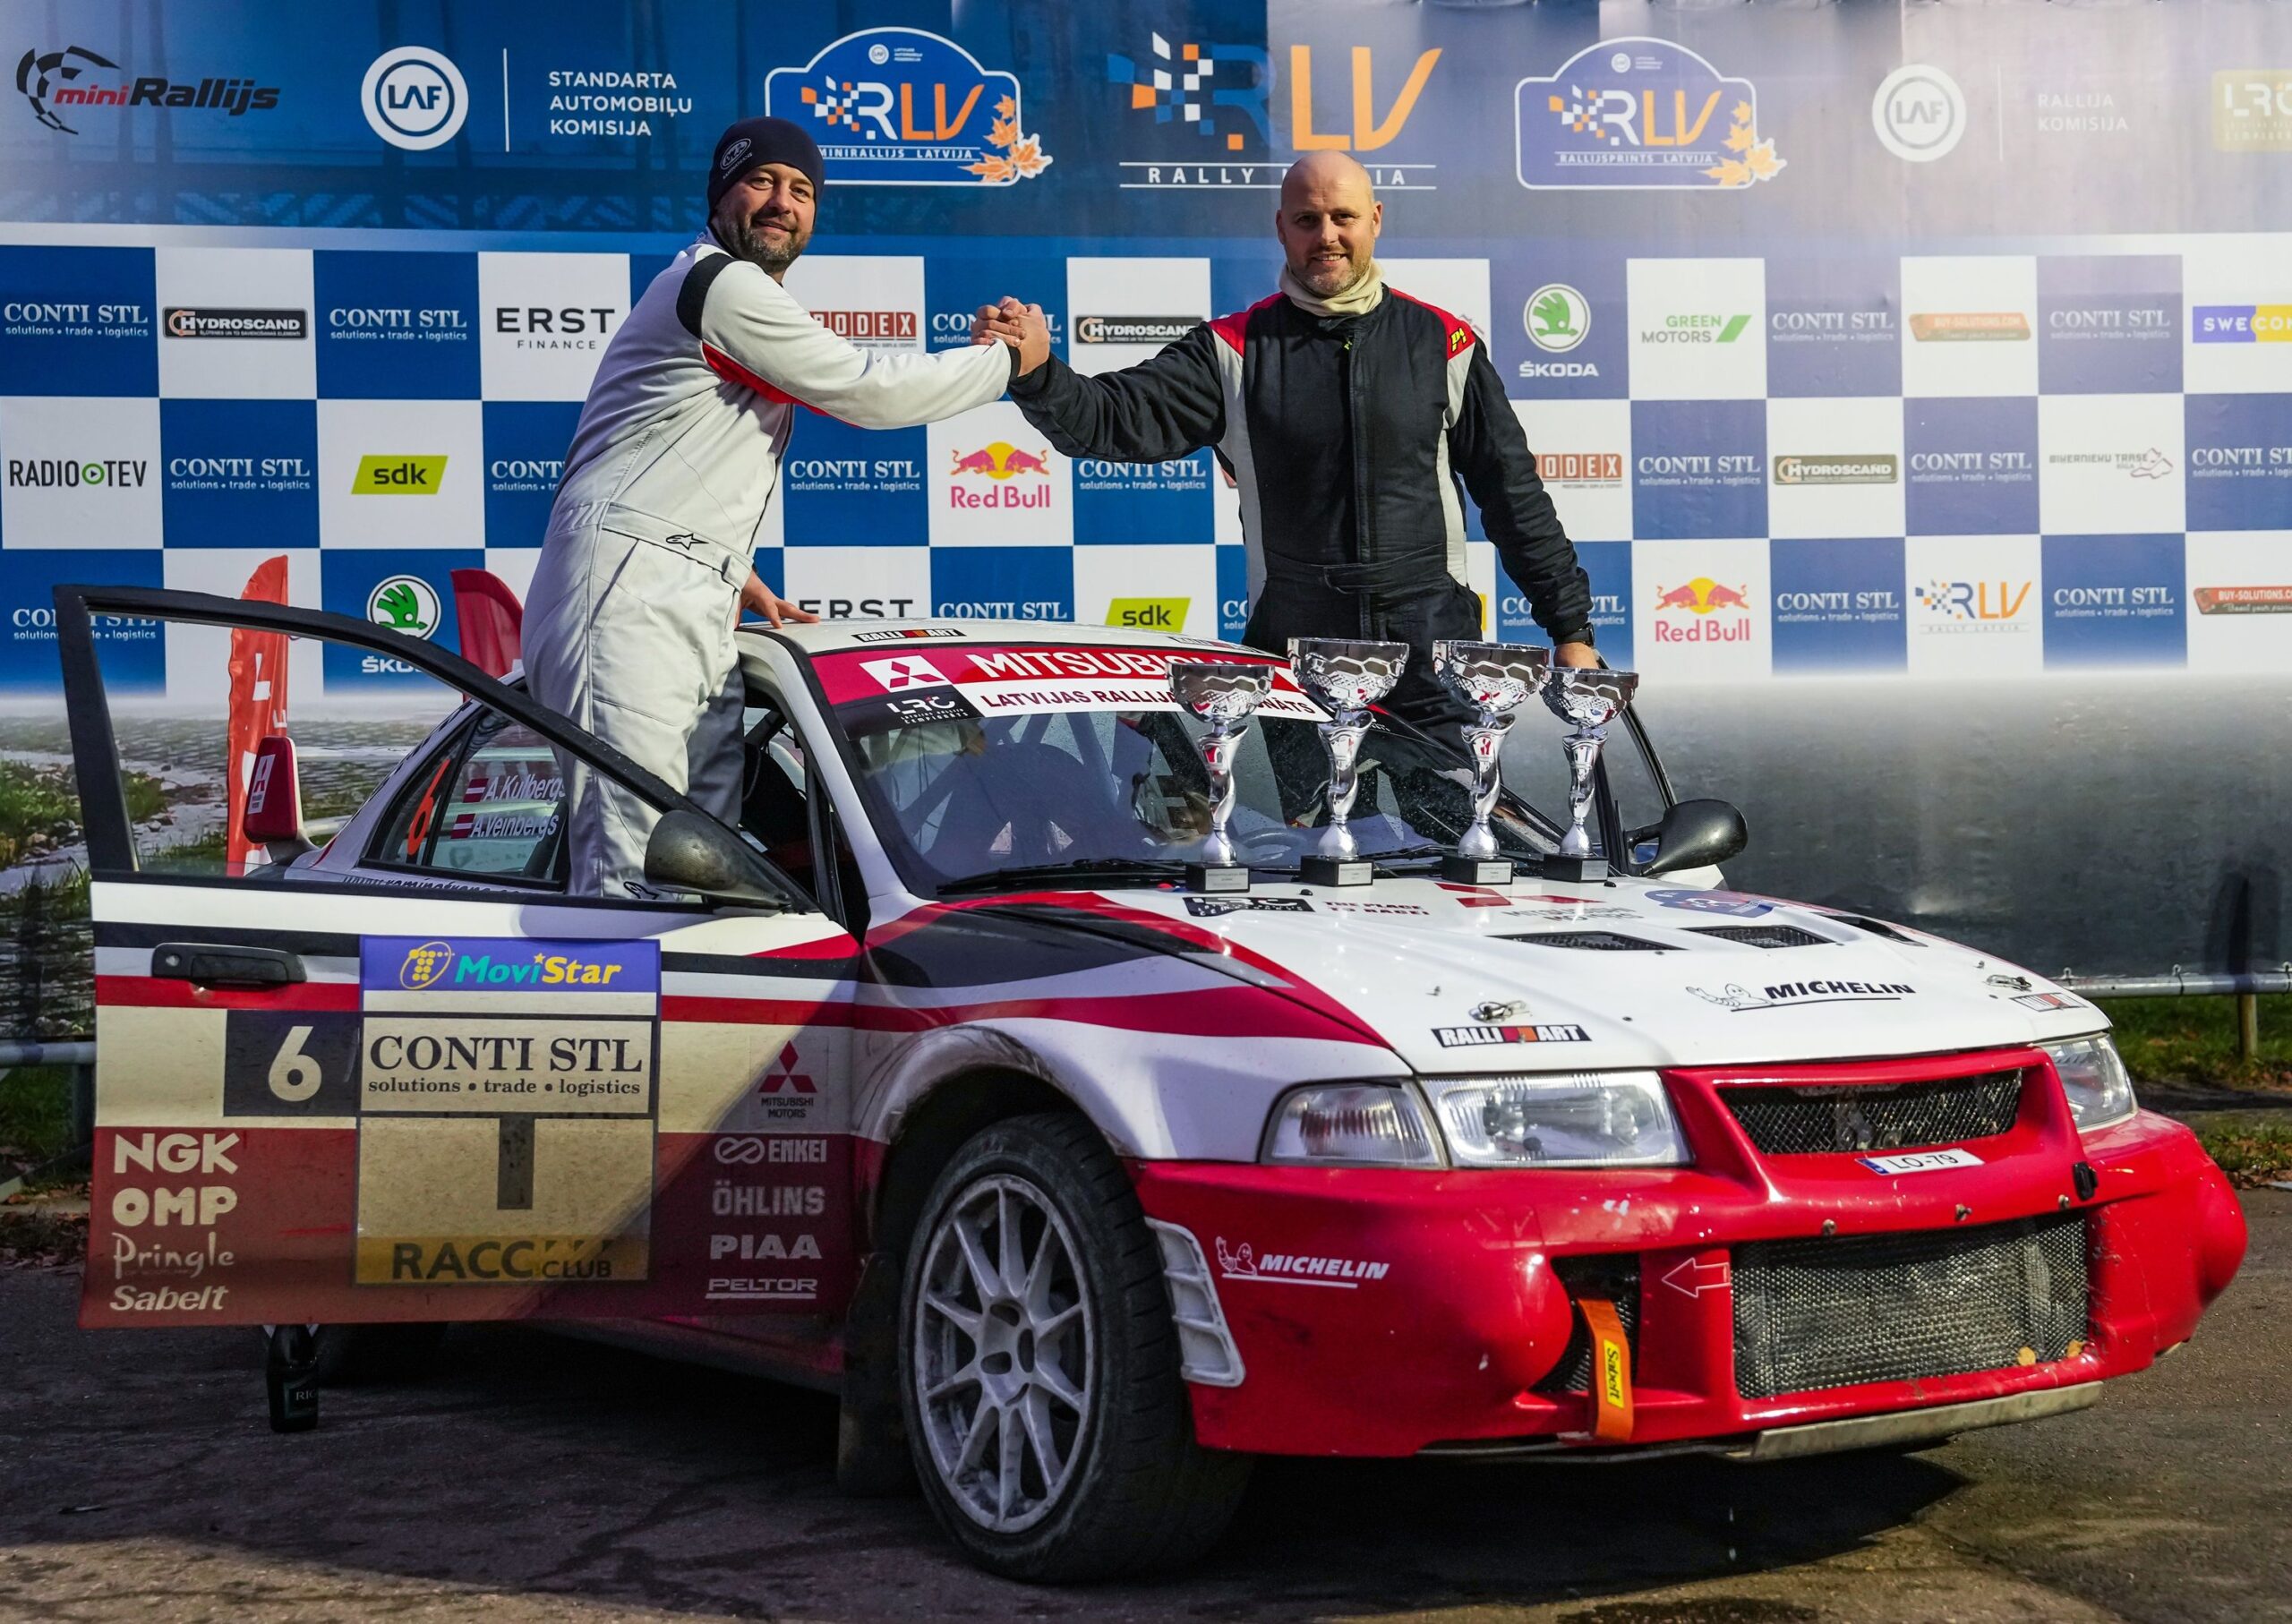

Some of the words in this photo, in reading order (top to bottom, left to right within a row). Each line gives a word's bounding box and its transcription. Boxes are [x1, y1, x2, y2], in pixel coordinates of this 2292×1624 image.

[549, 71, 677, 90] STANDARTA
[388, 85, 442, 109] LAF
[550, 95, 693, 117] AUTOMOBIĻU
[1211, 44, 1442, 151] RLV
[2038, 93, 2114, 109] RALLIJA
[858, 82, 984, 141] RLV
[1603, 90, 1723, 146] RLV
[1894, 99, 1944, 124] LAF
[551, 118, 652, 137] KOMISIJA
[2038, 116, 2128, 132] KOMISIJA
[917, 148, 973, 159] LATVIJA
[1560, 154, 1655, 164] RALLIJSPRINTS
[1663, 154, 1714, 164] LATVIJA
[1148, 167, 1253, 184] RALLY
[4, 303, 89, 323] CONTI
[98, 305, 148, 323] STL
[329, 308, 411, 328] CONTI
[419, 310, 467, 328] STL
[497, 307, 615, 333] ERST
[1665, 315, 1722, 328] GREEN
[1772, 313, 1844, 330] CONTI
[1852, 312, 1894, 329] STL
[2049, 312, 2121, 328] CONTI
[2128, 311, 2170, 328] STL
[5, 326, 54, 336] solutions
[65, 327, 93, 337] trade
[105, 327, 148, 338] logistics
[181, 317, 300, 329] HYDROSCAND
[330, 329, 377, 339] solutions
[388, 330, 414, 340] trade
[425, 330, 467, 342] logistics
[517, 339, 596, 349] FINANCE
[934, 334, 971, 344] solution
[1641, 331, 1711, 343] MOTORS
[1519, 361, 1599, 377] ŠKODA
[1638, 457, 1711, 474] CONTI
[1718, 456, 1761, 473] STL
[1911, 453, 1982, 470] CONTI
[1989, 452, 2032, 469] STL
[2192, 448, 2262, 466] CONTI
[2270, 447, 2292, 465] ST
[9, 459, 79, 487] RADIO
[104, 461, 147, 487] TEV
[170, 458, 252, 477] CONTI
[261, 459, 310, 477] STL
[374, 463, 427, 485] sdk
[492, 460, 565, 479] CONT
[790, 461, 866, 478] CONTI
[875, 461, 920, 478] STL
[1079, 460, 1154, 478] CONTI
[1161, 460, 1206, 477] STL
[1789, 464, 1892, 476] HYDROSCAND
[171, 480, 218, 490] solutions
[230, 480, 257, 490] trade
[268, 480, 310, 491] logistics
[492, 483, 538, 491] solutions
[791, 482, 835, 491] solutions
[844, 482, 870, 491] trade
[881, 482, 920, 491] logistics
[1080, 481, 1124, 490] solutions
[1133, 481, 1158, 491] trade
[1167, 481, 1206, 491] logistics
[1639, 477, 1681, 486] solutions
[1689, 477, 1715, 486] trade
[1723, 476, 1761, 486] logistics
[951, 485, 998, 508] Red
[1005, 485, 1050, 508] Bull
[1777, 593, 1851, 611] CONTI
[1857, 591, 1899, 610] STL
[1951, 581, 2031, 620] RLV
[2054, 588, 2125, 606] CONTI
[2132, 587, 2174, 604] STL
[938, 602, 1014, 620] CONTI
[1022, 602, 1068, 620] STL
[1122, 605, 1172, 626] sdk
[1778, 612, 1819, 621] solutions
[1828, 612, 1853, 621] trade
[1861, 612, 1899, 623] logistics
[2055, 609, 2095, 618] solutions
[2104, 609, 2129, 618] trade
[2137, 608, 2174, 619] logistics
[13, 630, 58, 640] solution
[113, 630, 156, 640] logistics
[860, 629, 902, 642] RALLI
[926, 628, 959, 637] ART
[1655, 620, 1700, 642] Red
[1706, 619, 1750, 642] Bull
[980, 690, 1091, 707] LATVIJAS
[455, 953, 621, 985] MoviStar
[1764, 981, 1916, 1000] MICHELIN
[1440, 1027, 1503, 1047] RALLI
[1537, 1025, 1582, 1042] ART
[370, 1035, 535, 1072] CONTI
[550, 1038, 643, 1073] STL
[269, 1026, 322, 1102] 6
[369, 1077, 461, 1093] solutions
[483, 1079, 537, 1093] trade
[559, 1079, 641, 1098] logistics
[761, 1098, 814, 1107] MITSUBISHI
[768, 1108, 806, 1118] MOTORS
[114, 1133, 240, 1175] NGK
[768, 1139, 827, 1163] ENKEI
[112, 1186, 238, 1227] OMP
[712, 1181, 825, 1216] ÖHLINS
[111, 1232, 235, 1279] Pringle
[710, 1235, 823, 1260] PIAA
[392, 1240, 535, 1280] RACC
[542, 1260, 612, 1279] CLUB
[1260, 1253, 1390, 1280] MICHELIN
[708, 1278, 818, 1292] PELTOR
[109, 1286, 229, 1311] Sabelt
